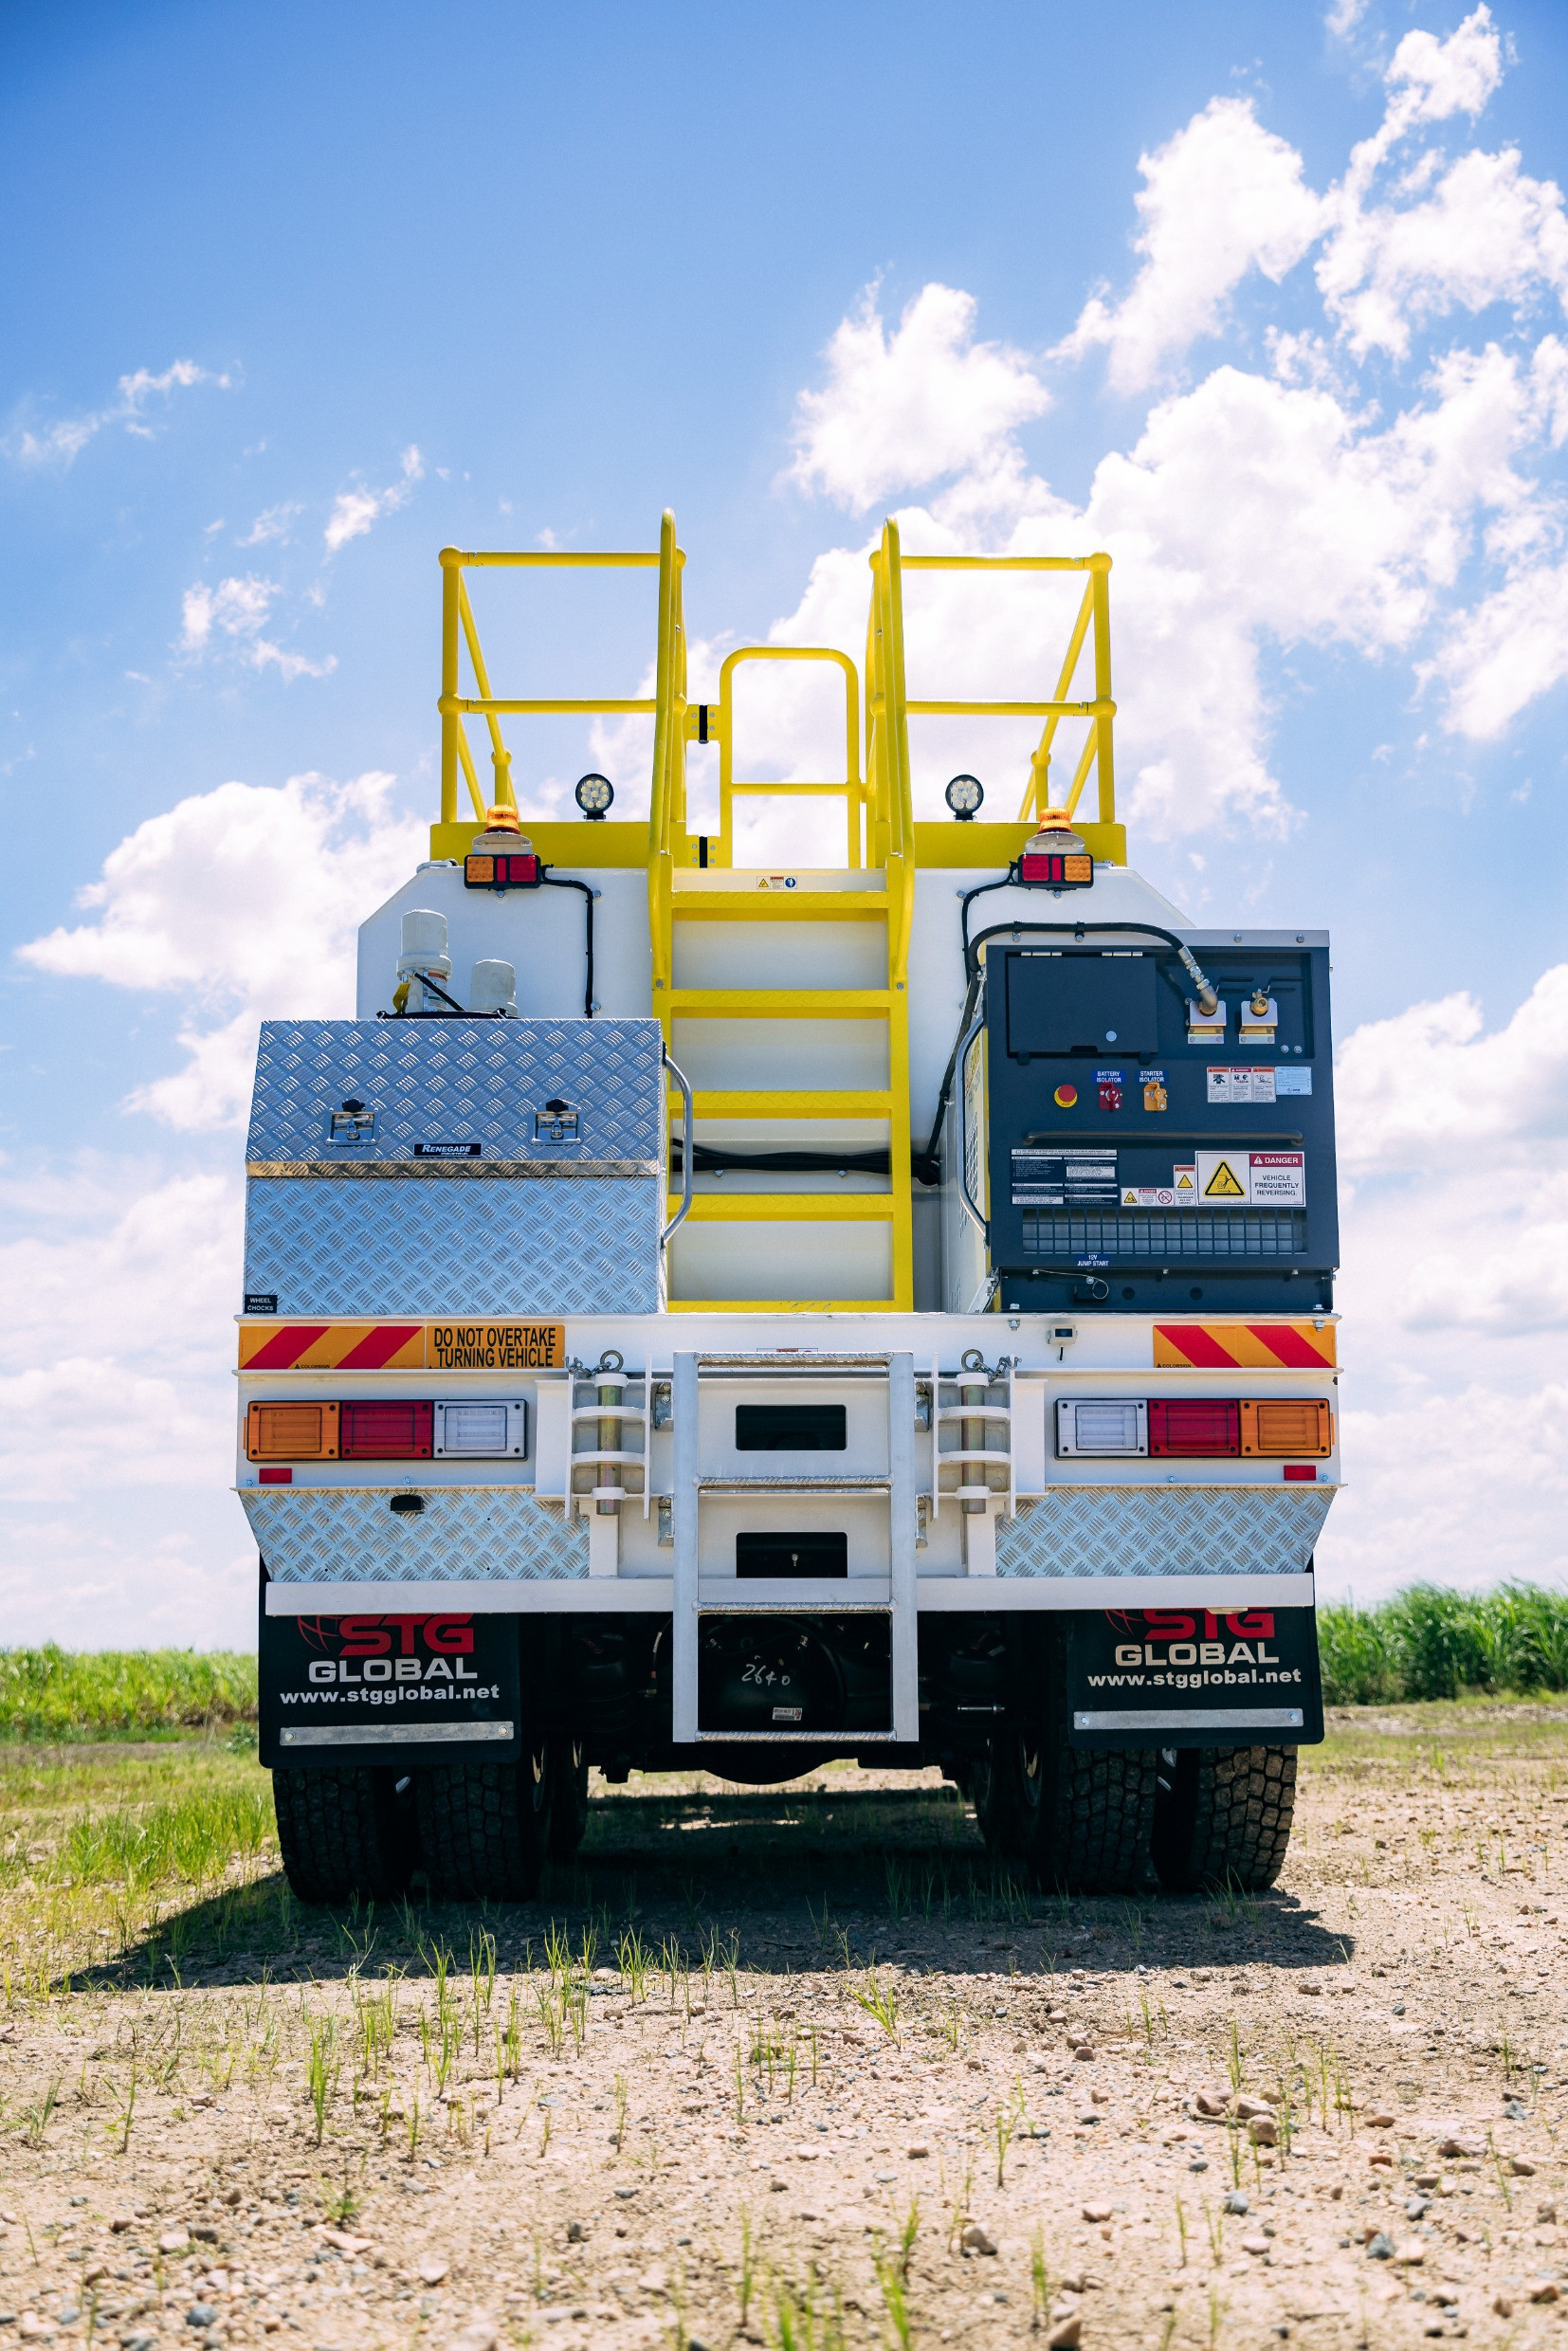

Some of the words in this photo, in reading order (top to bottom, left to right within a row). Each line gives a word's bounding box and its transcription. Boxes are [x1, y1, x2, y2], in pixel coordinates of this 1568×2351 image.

[422, 1144, 471, 1152] RENEGADE
[434, 1328, 453, 1347] DO
[457, 1328, 483, 1347] NOT
[487, 1328, 556, 1347] OVERTAKE
[437, 1348, 494, 1367] TURNING
[498, 1348, 553, 1367] VEHICLE
[338, 1613, 474, 1656] STG
[1143, 1608, 1275, 1640] STG
[1115, 1642, 1279, 1666] GLOBAL
[308, 1658, 478, 1683] GLOBAL
[1088, 1668, 1301, 1689] www.stgglobal.net
[280, 1684, 500, 1705] www.stgglobal.net
